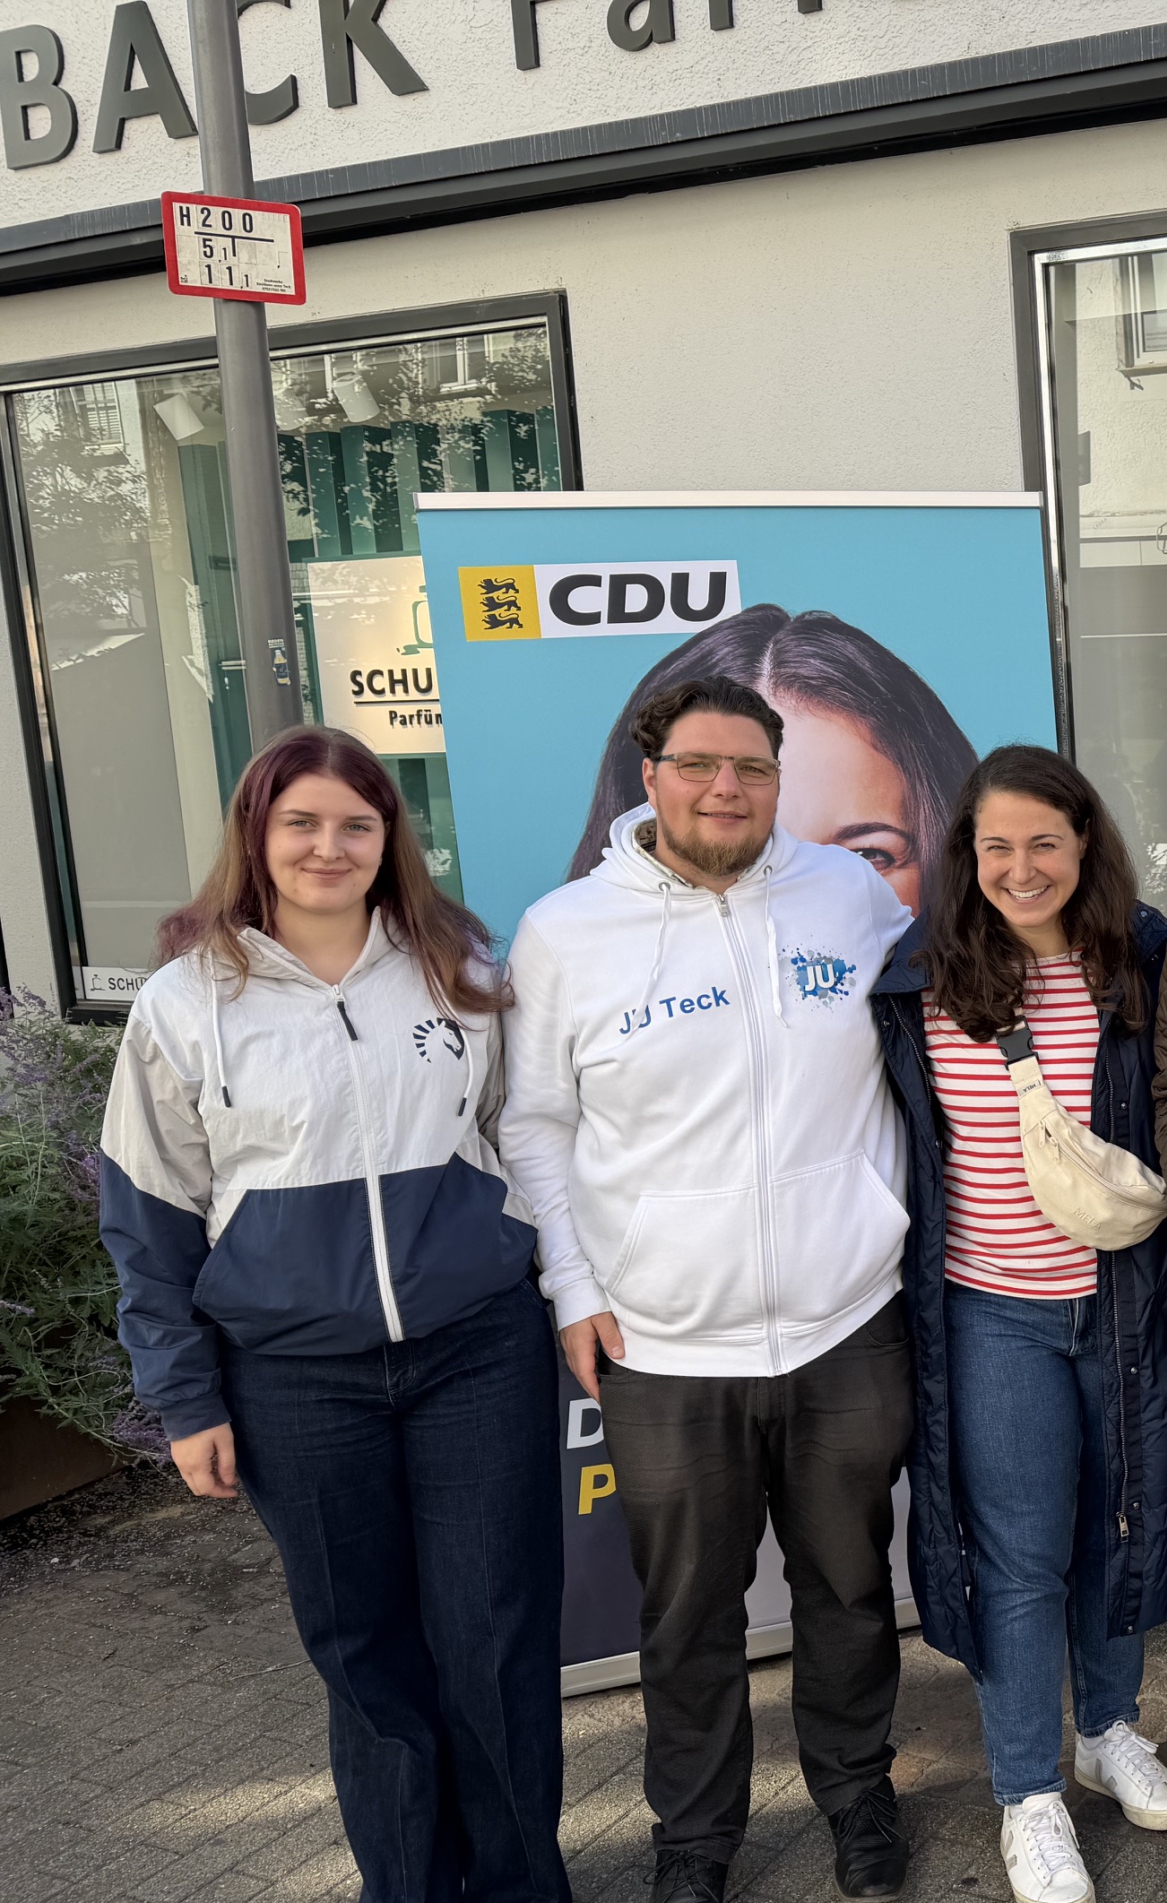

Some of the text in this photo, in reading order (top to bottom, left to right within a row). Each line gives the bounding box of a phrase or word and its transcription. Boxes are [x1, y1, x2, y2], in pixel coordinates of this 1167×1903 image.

[549, 571, 727, 626] CDU
[350, 667, 433, 697] SCHU
[804, 963, 836, 991] JU
[619, 986, 730, 1034] JU Teck
